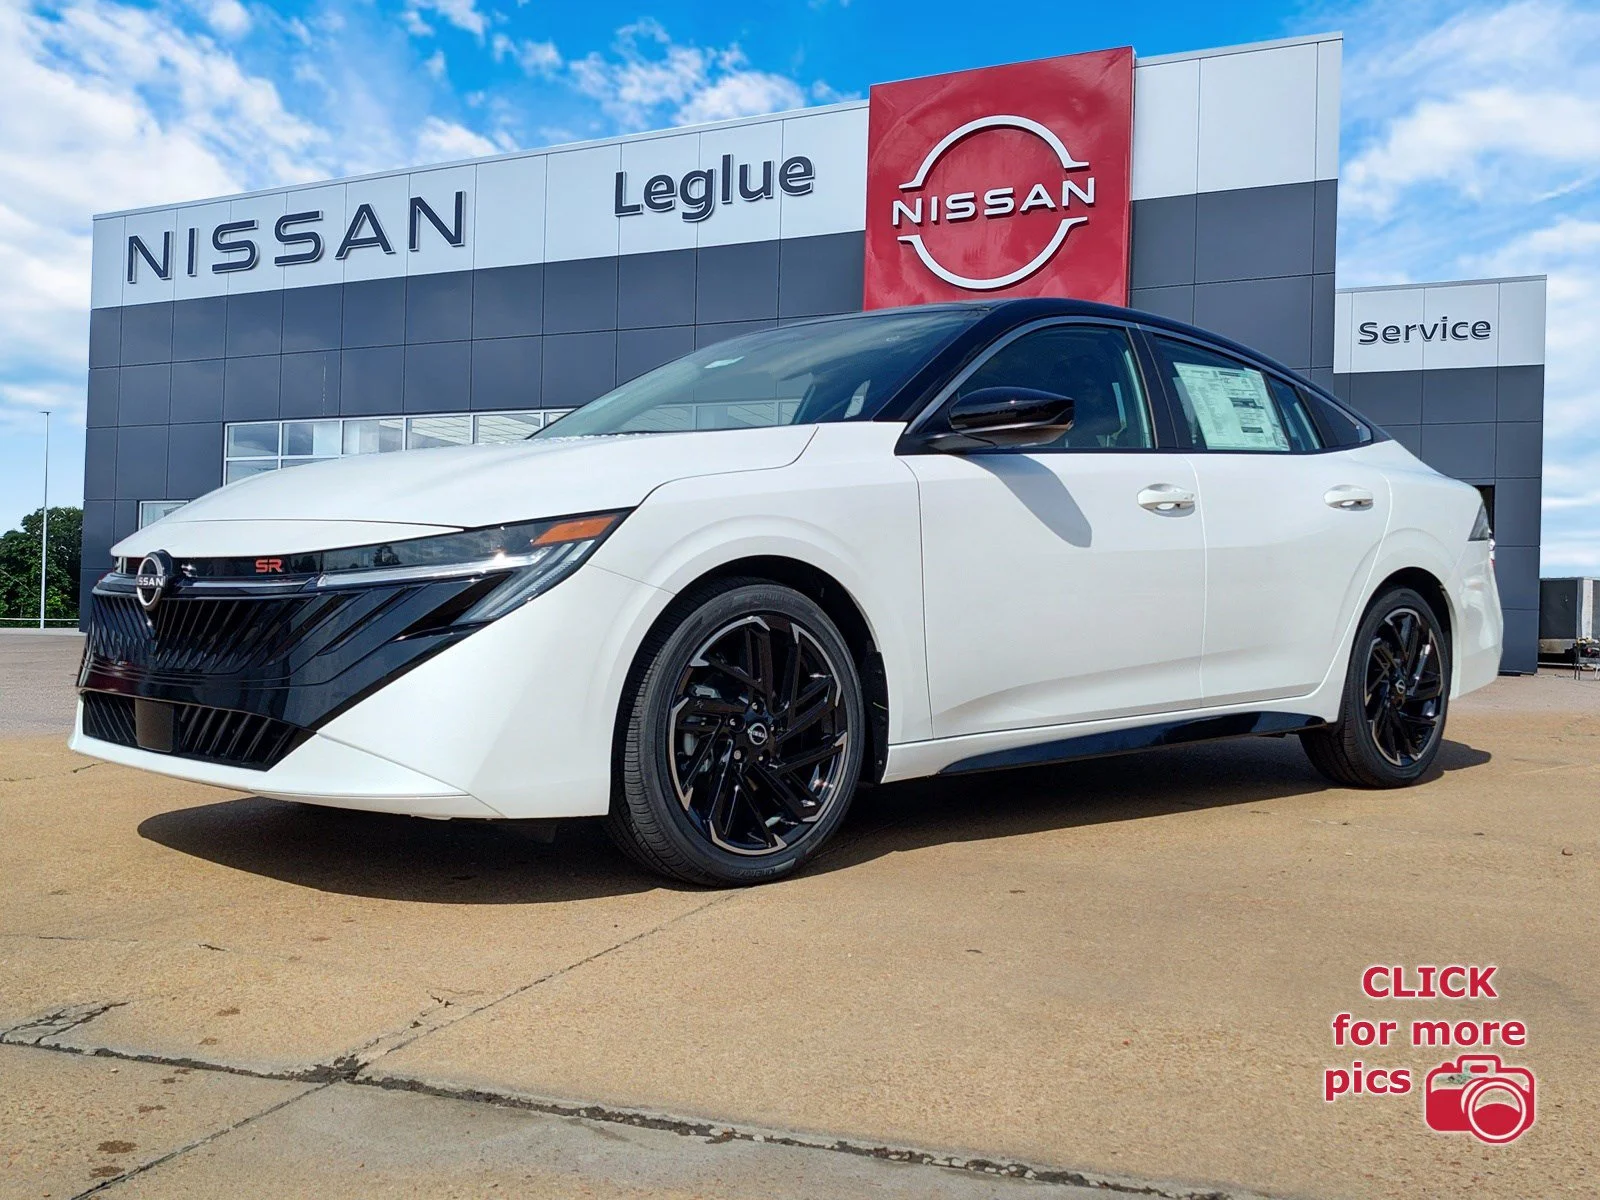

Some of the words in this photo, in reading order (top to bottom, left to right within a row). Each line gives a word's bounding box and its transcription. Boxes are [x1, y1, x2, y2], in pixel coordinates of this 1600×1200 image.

[614, 154, 815, 222] Leglue
[893, 177, 1095, 226] NISSAN
[127, 190, 466, 284] NISSAN
[1358, 316, 1492, 345] Service
[255, 558, 283, 573] SR
